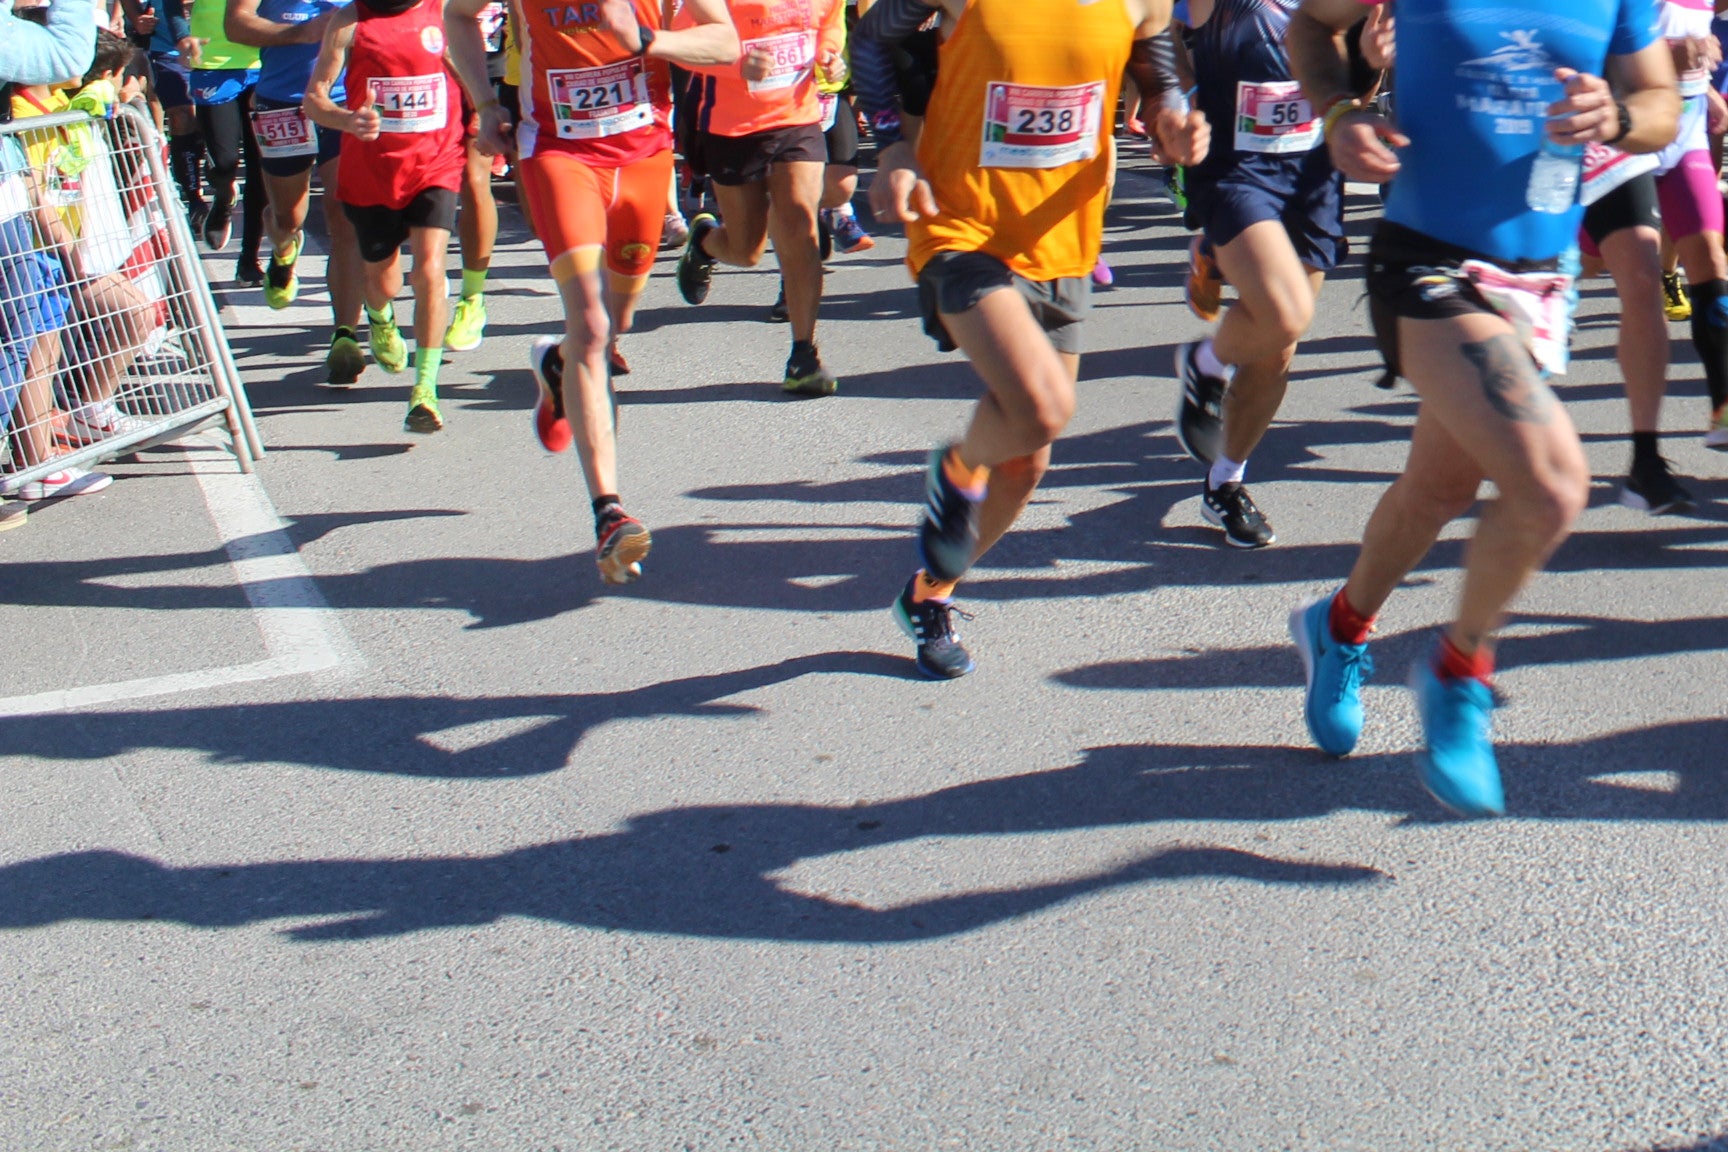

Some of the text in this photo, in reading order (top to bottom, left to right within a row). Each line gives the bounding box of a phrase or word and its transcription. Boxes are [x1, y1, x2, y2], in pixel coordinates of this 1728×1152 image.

[391, 92, 427, 109] 144
[576, 83, 622, 109] 221
[1017, 110, 1072, 133] 238
[1272, 102, 1298, 124] 56
[266, 121, 299, 139] 515
